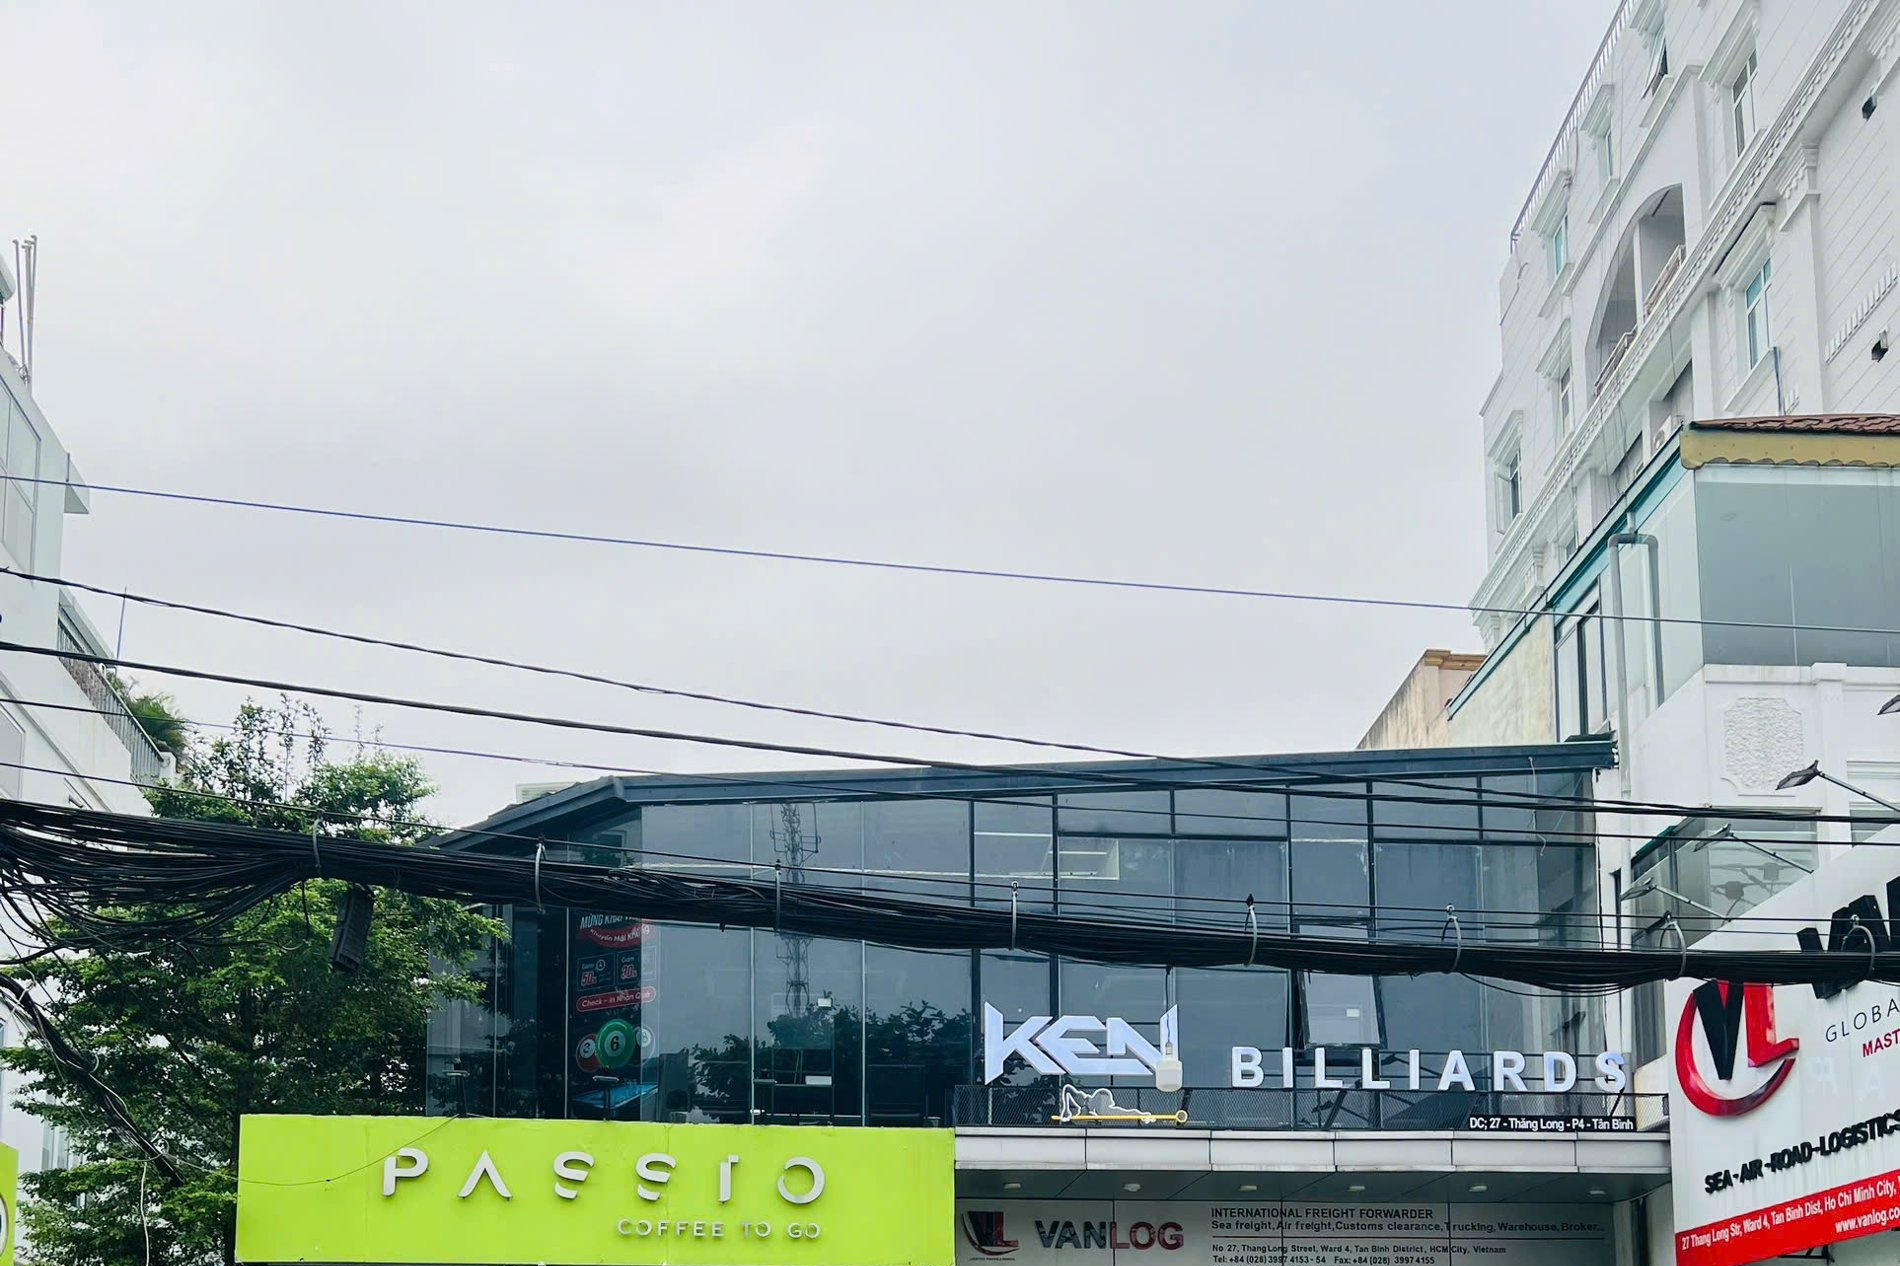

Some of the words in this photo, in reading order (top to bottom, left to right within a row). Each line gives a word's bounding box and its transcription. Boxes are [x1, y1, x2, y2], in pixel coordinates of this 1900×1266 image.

[1796, 875, 1900, 1000] VA
[610, 1036, 620, 1052] 6
[984, 1001, 1179, 1085] KEN
[1231, 1045, 1626, 1093] BILLIARDS
[1489, 1117, 1501, 1129] 27
[1540, 1118, 1565, 1132] Long
[1572, 1118, 1585, 1130] P4
[382, 1147, 826, 1206] PASSIO
[1211, 1208, 1302, 1218] INTERNATIONAL
[1305, 1208, 1355, 1219] FREIGHT
[1360, 1209, 1433, 1219] FORWARDER
[1681, 1236, 1690, 1250] 27
[1690, 1233, 1711, 1247] Thang
[1712, 1228, 1729, 1242] Long
[1743, 1214, 1762, 1234] Ward
[1771, 1210, 1785, 1225] Tan
[1785, 1203, 1804, 1222] Binh
[1824, 1196, 1837, 1211] Ho
[1837, 1189, 1853, 1208] Chi
[1853, 1184, 1875, 1204] Minh
[617, 1218, 724, 1238] COFFEE
[743, 1220, 771, 1238] TO
[787, 1222, 821, 1239] GO
[1034, 1220, 1184, 1250] VANLOG
[1211, 1221, 1231, 1229] Sea
[1320, 1245, 1342, 1253] Ward
[1354, 1245, 1369, 1253] Tan
